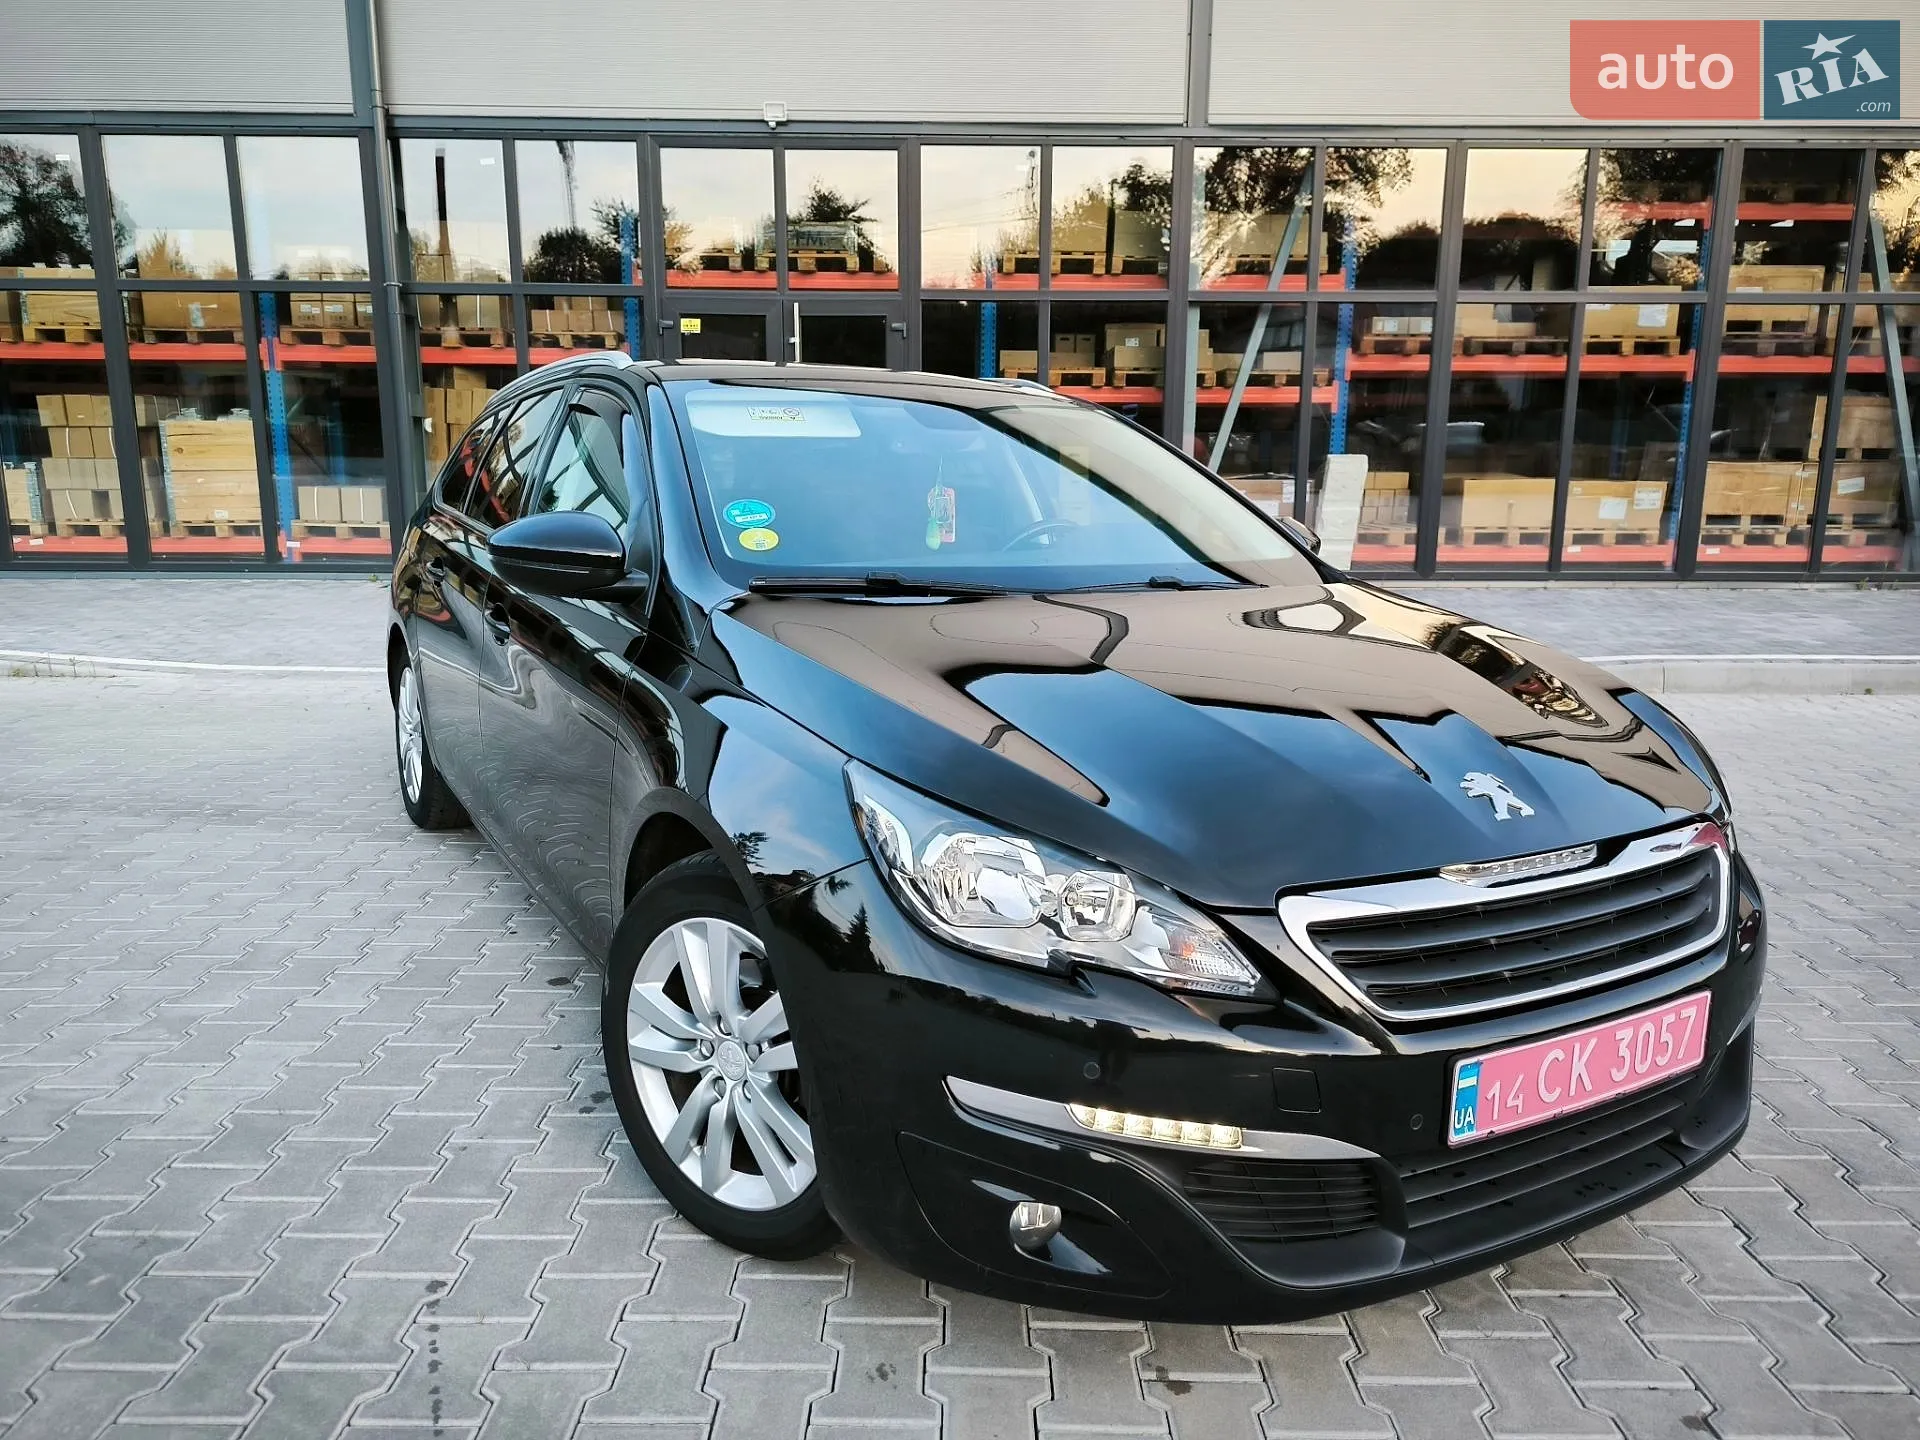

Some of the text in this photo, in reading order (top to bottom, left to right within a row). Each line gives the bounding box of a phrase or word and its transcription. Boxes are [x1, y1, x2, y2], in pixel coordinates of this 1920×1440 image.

[1485, 1007, 1698, 1120] 14 CK 3057
[1455, 1105, 1475, 1129] UA
